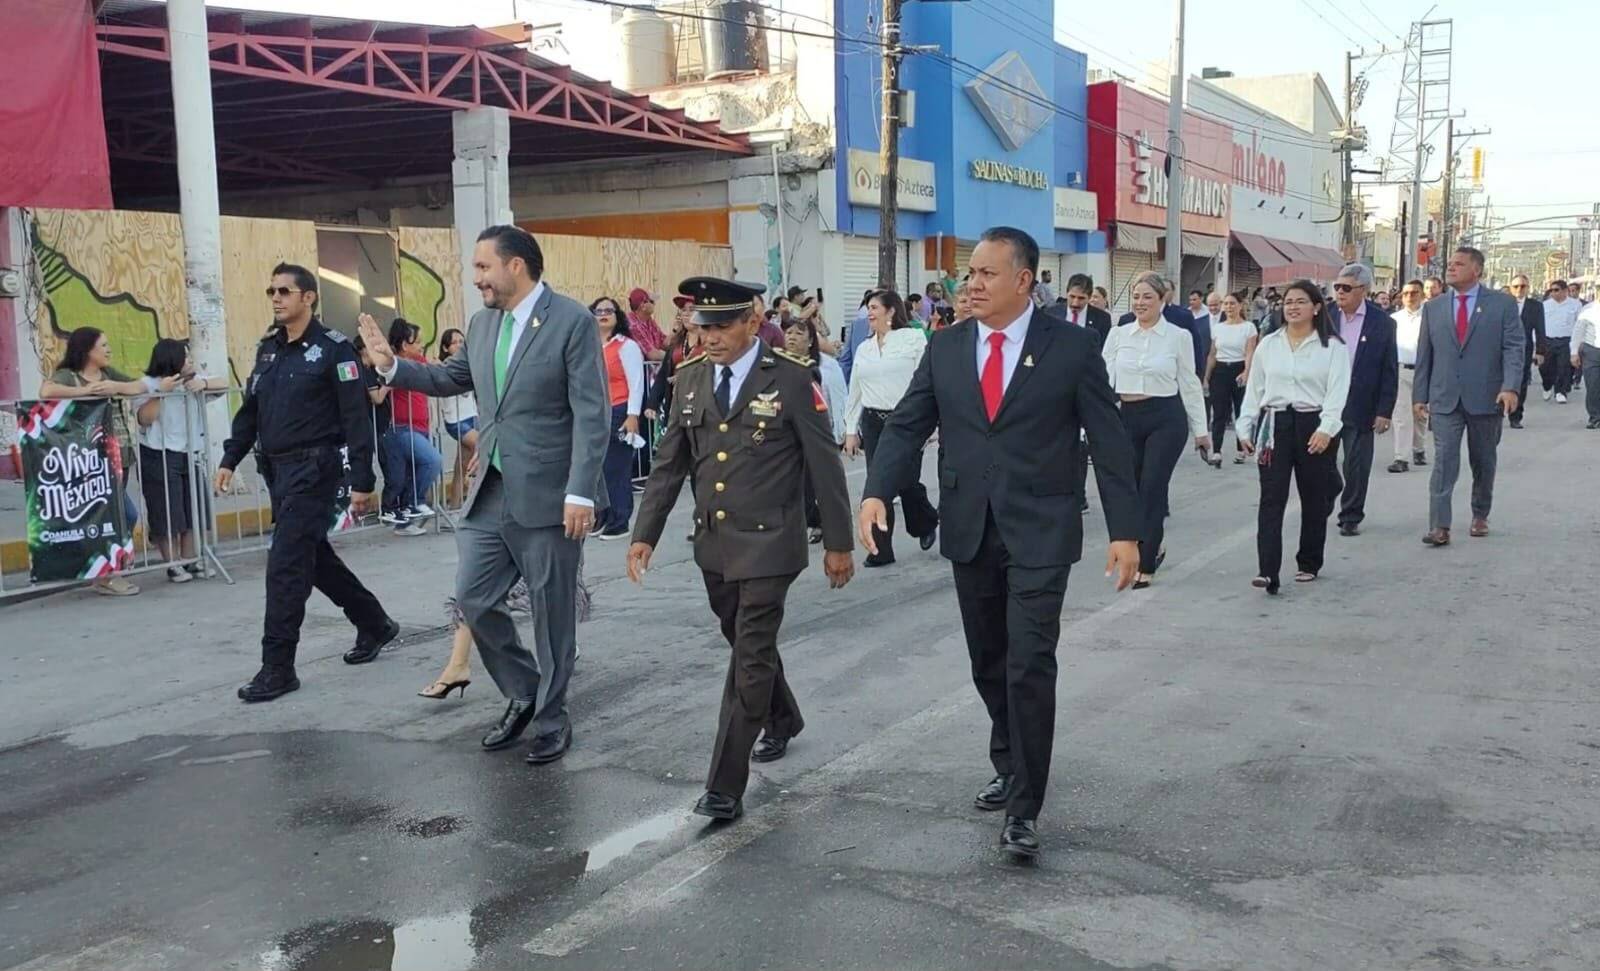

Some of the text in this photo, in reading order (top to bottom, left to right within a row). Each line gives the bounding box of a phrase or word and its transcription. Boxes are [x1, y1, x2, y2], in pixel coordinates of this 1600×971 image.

[974, 159, 1012, 182] SALINAS
[1018, 167, 1049, 191] ROCHA
[1233, 129, 1286, 198] milano
[904, 178, 935, 198] Azteca
[1153, 165, 1229, 218] HEMANOS
[1056, 203, 1096, 220] Banco Azteca
